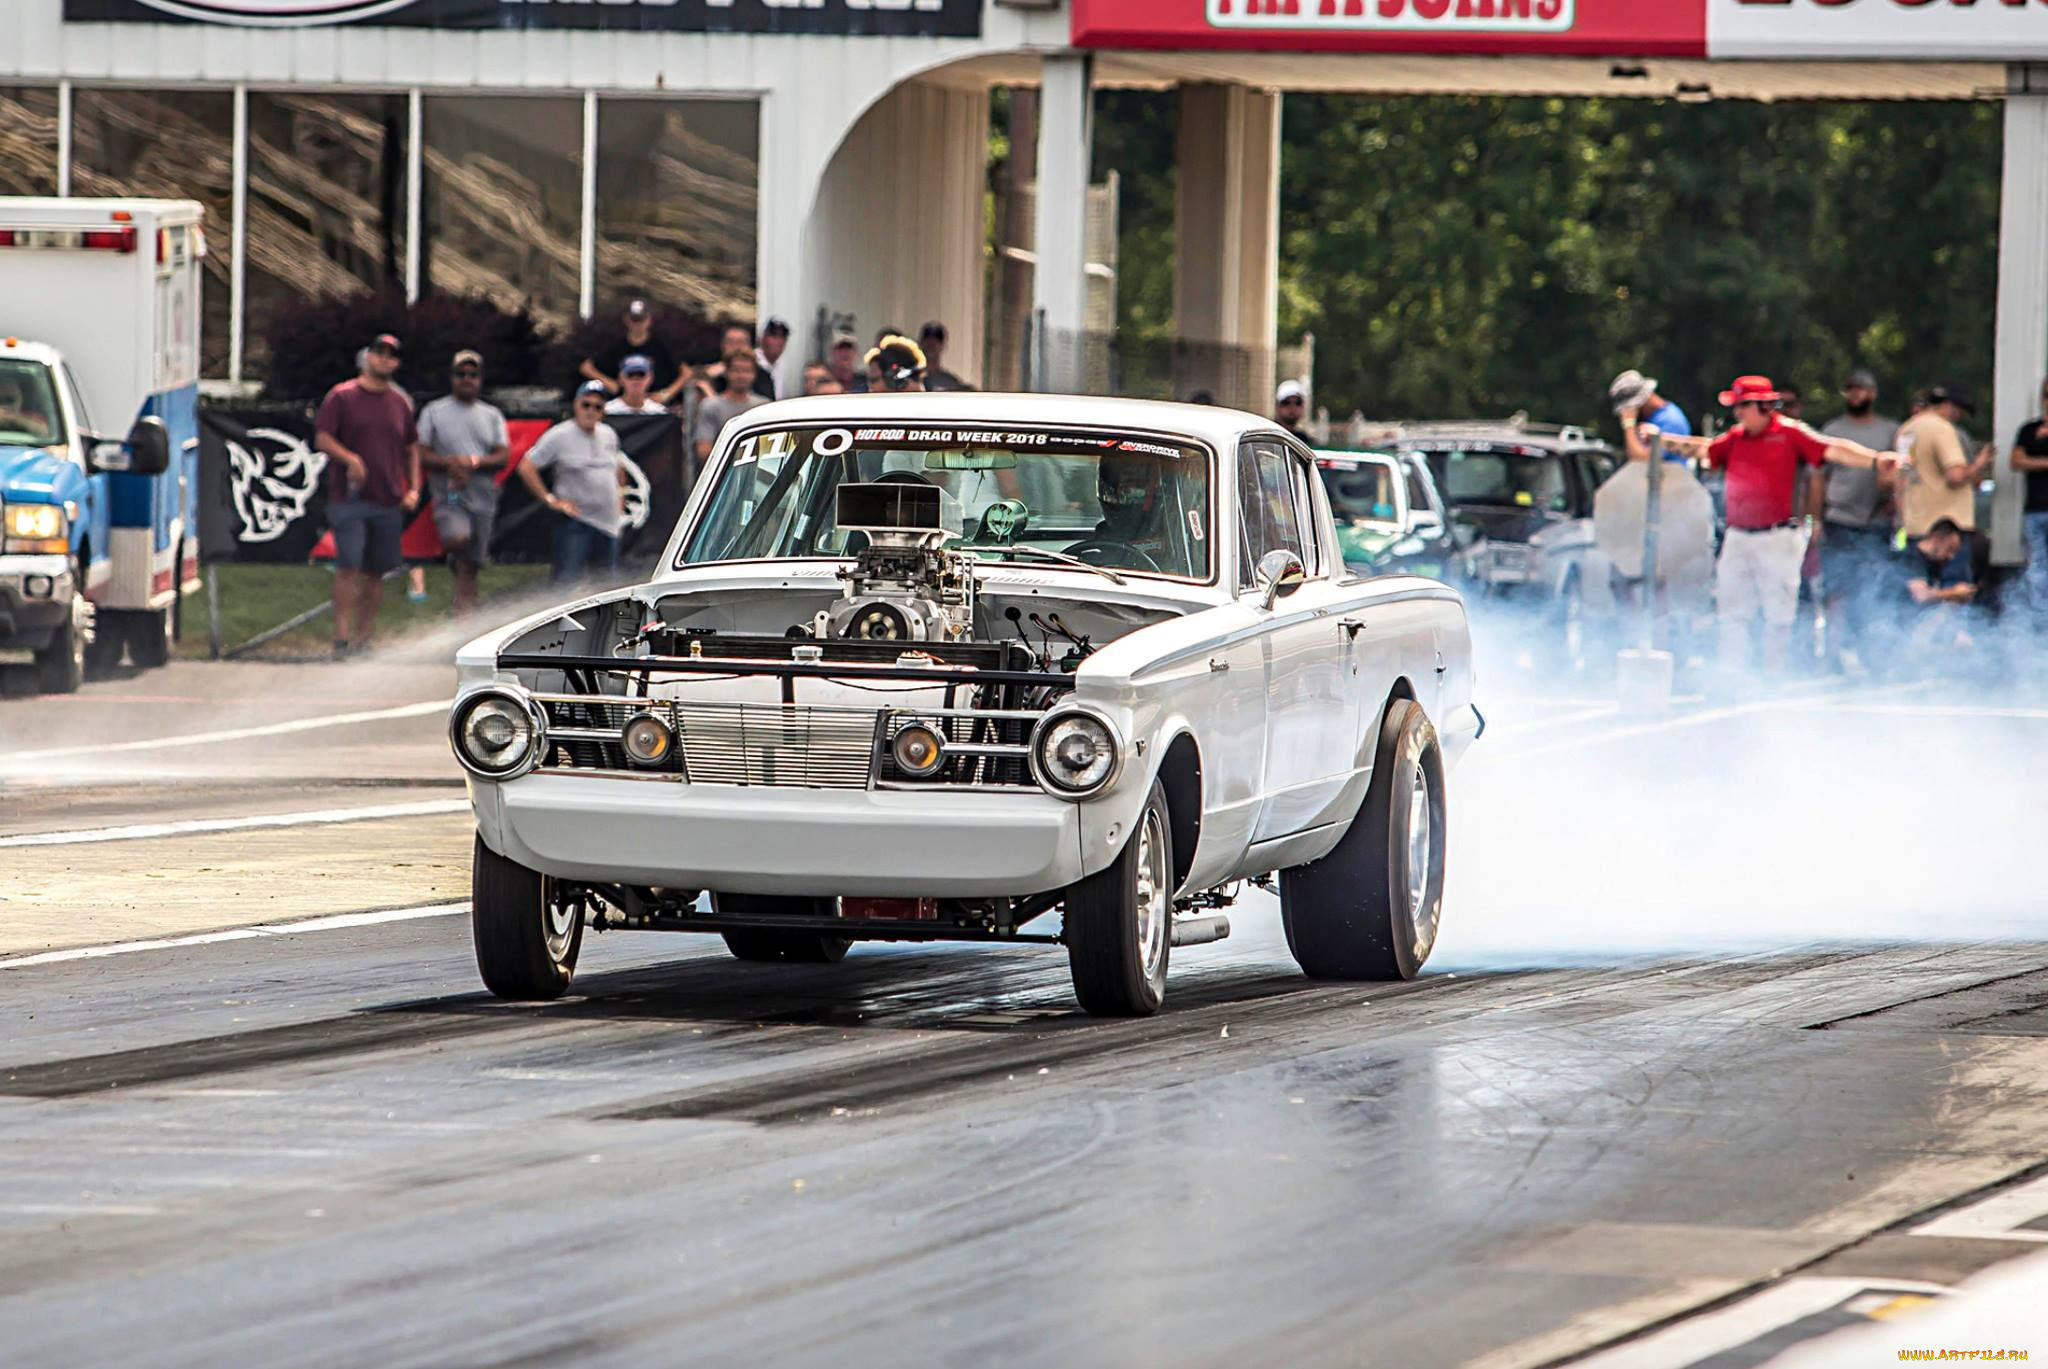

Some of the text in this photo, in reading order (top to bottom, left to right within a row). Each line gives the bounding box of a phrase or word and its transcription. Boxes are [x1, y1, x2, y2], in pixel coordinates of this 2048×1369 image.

[908, 430, 952, 441] DRAG
[956, 431, 1003, 443] WEEK
[1006, 433, 1048, 444] 2018
